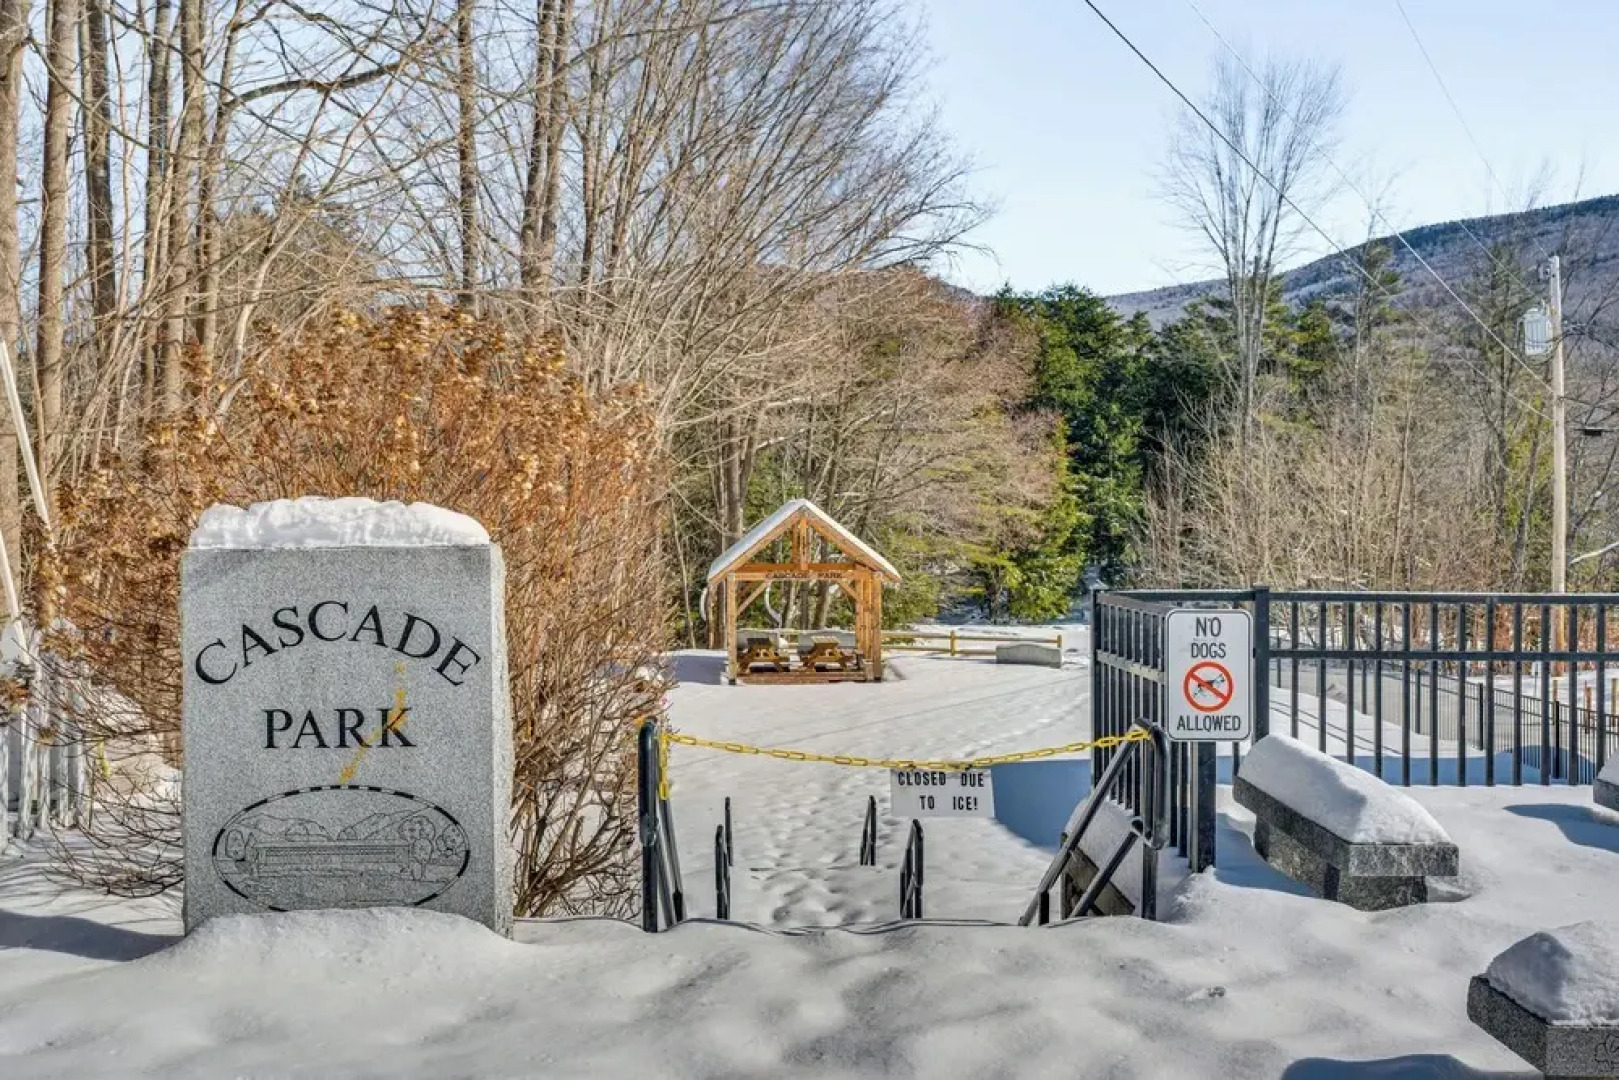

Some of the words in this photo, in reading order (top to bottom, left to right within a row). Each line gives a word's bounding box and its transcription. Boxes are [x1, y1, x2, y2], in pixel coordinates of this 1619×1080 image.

[1195, 617, 1222, 637] NO
[195, 601, 481, 687] CASCADE
[1191, 642, 1227, 658] DOGS
[261, 707, 416, 749] PARK
[1177, 715, 1241, 732] ALLOWED
[898, 771, 946, 786] CLOSED
[961, 772, 984, 787] DUE
[919, 795, 935, 810] TO
[953, 796, 978, 811] ICE!
